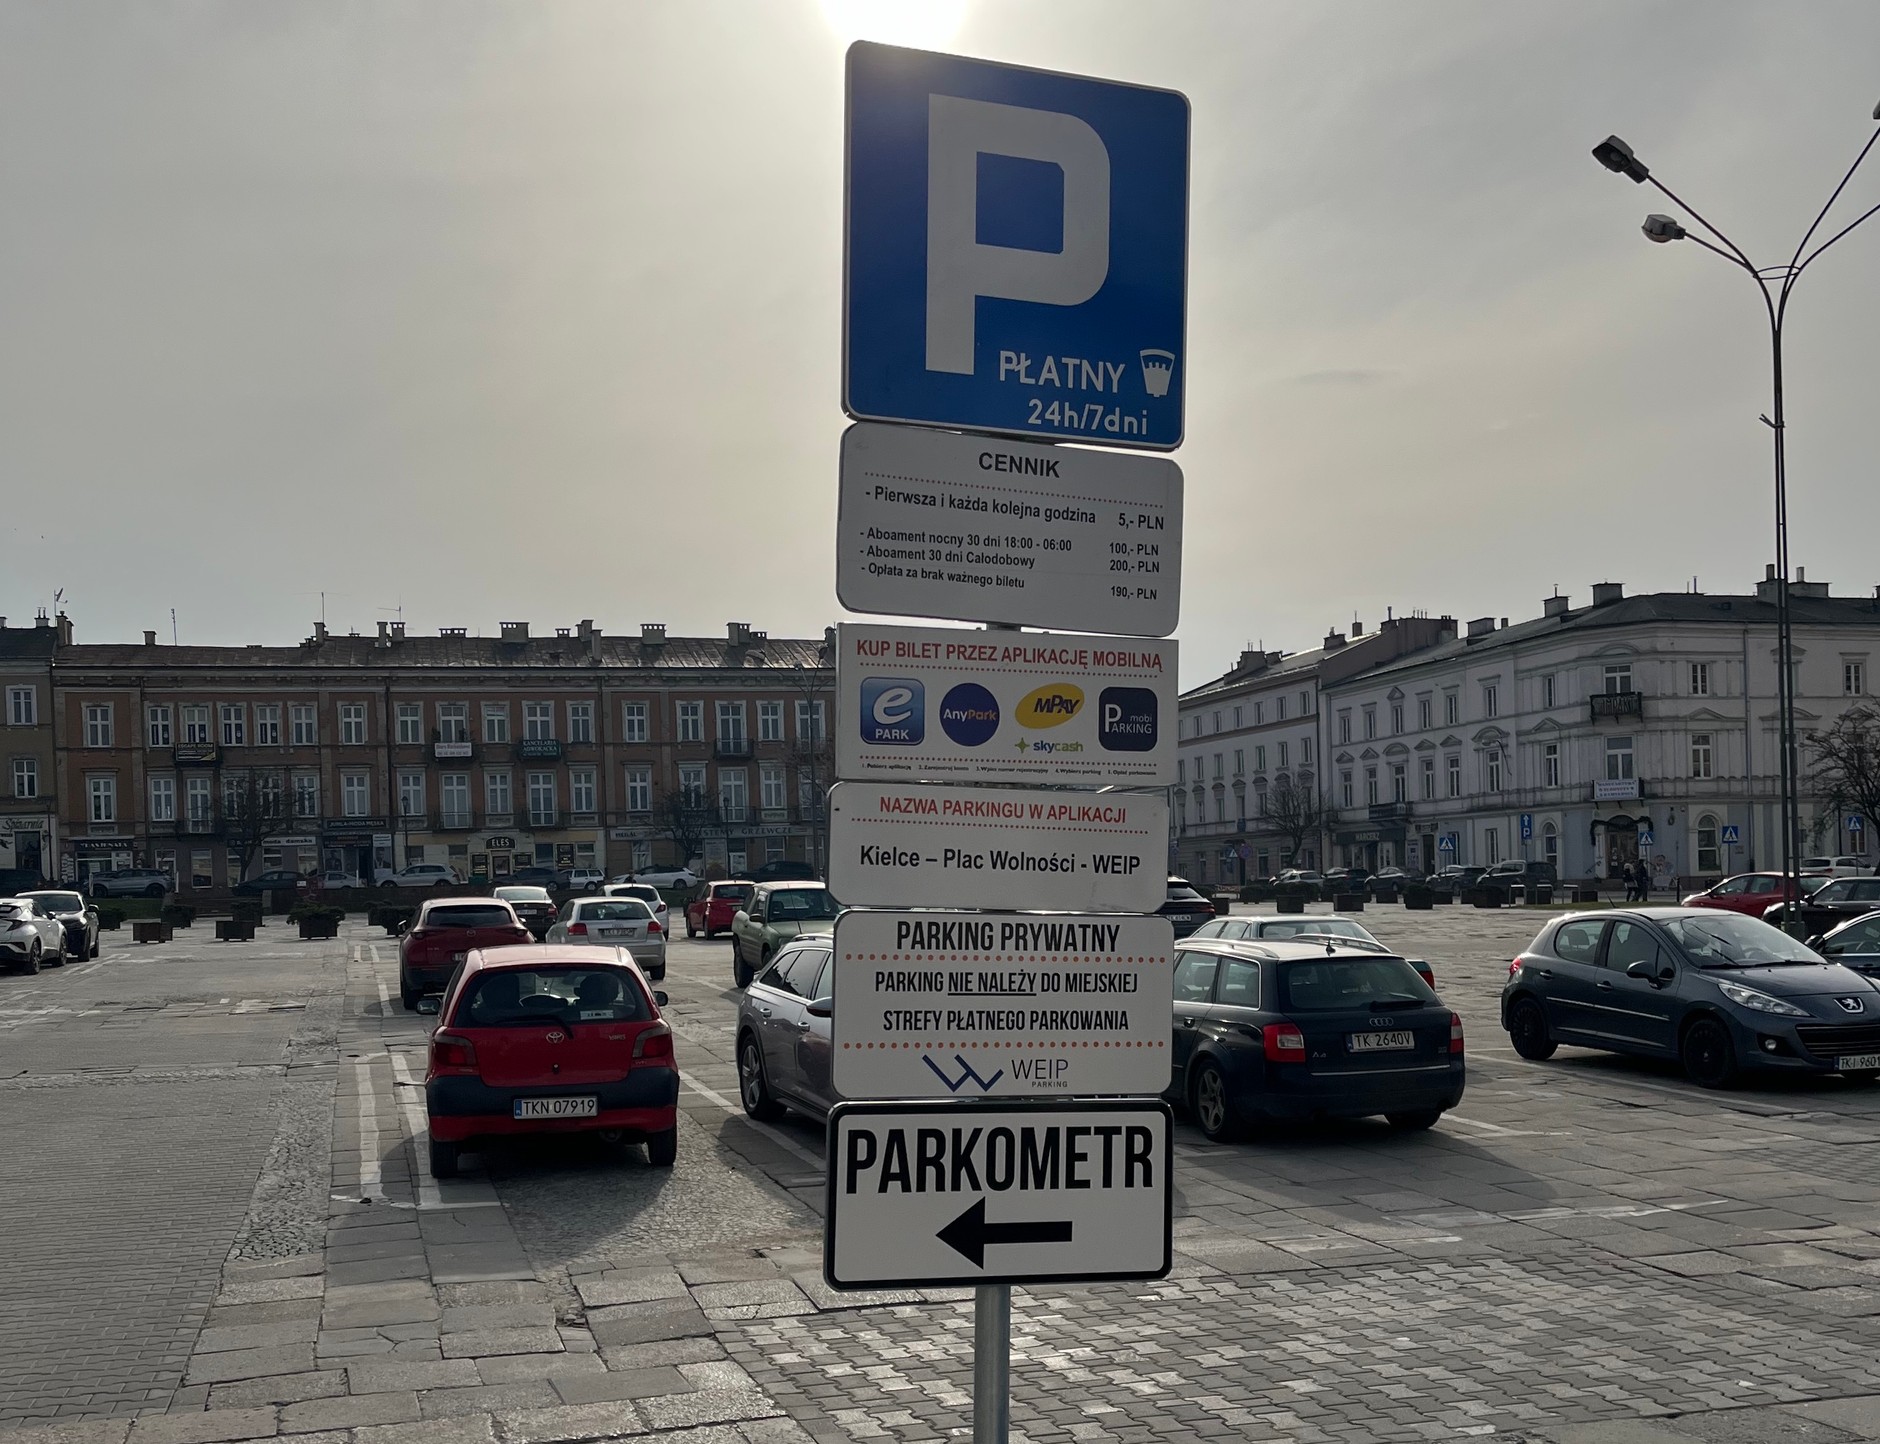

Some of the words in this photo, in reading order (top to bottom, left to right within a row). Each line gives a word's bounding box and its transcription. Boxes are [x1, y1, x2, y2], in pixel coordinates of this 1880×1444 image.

[925, 93, 1111, 375] P
[1000, 350, 1125, 393] PŁATNY
[1027, 399, 1148, 435] 24h/7dni
[978, 452, 1060, 478] CENNIK
[874, 485, 937, 507] Pierwsza
[941, 493, 945, 507] i
[949, 494, 988, 512] każda
[992, 499, 1040, 520] kolejna
[1044, 506, 1096, 524] godzina
[1138, 514, 1164, 530] PLN
[866, 527, 926, 543] Aboament
[929, 535, 964, 548] nocny
[967, 534, 980, 546] 30
[983, 535, 1000, 547] dni
[1004, 536, 1033, 549] 18:00
[1043, 538, 1072, 551] 06:00
[866, 545, 926, 561] Aboament
[929, 549, 942, 561] 30
[945, 550, 963, 563] dni
[1137, 544, 1159, 556] PLN
[868, 562, 903, 577] Opłata
[905, 568, 918, 578] za
[921, 568, 944, 581] brak
[947, 571, 993, 588] ważnego
[996, 575, 1025, 588] biletu
[1138, 561, 1160, 573] PLN
[1137, 588, 1157, 600] PLN
[856, 639, 891, 657] KUP
[895, 641, 942, 659] BILET
[946, 644, 998, 662] PRZEZ
[1001, 646, 1088, 669] APLIKACJĘ
[1093, 651, 1163, 672] MOBILNĄ
[943, 708, 997, 722] AnyPark
[1104, 703, 1152, 734] PARKING
[1129, 713, 1152, 723] mobi
[875, 728, 909, 740] PARK
[1033, 740, 1084, 753] skycash
[880, 796, 938, 815] NAZWA
[943, 799, 1024, 819] PARKINGU
[1029, 803, 1047, 820] W
[1047, 805, 1126, 824] APLIKACJI
[491, 838, 510, 847] ELES
[1523, 827, 1530, 838] P
[860, 845, 920, 867] Kielce
[943, 849, 984, 870] Plac
[990, 850, 1075, 873] Wolności
[1093, 854, 1140, 875] WEIP
[897, 920, 994, 951] PARKING
[1001, 922, 1120, 952] PRYWATNY
[875, 971, 944, 992] PARKING
[948, 972, 973, 993] NIE
[977, 969, 1037, 993] NALEŻY
[1040, 972, 1062, 993] DO
[1065, 973, 1138, 993] MIEJSKIEJ
[883, 1010, 943, 1031] STREFY
[947, 1010, 1025, 1031] PŁATNEGO
[1029, 1010, 1129, 1031] PARKOWANIA
[1354, 1034, 1371, 1048] TK
[1011, 1059, 1069, 1080] WEIP
[523, 1099, 551, 1115] TKN
[552, 1097, 596, 1114] 07919
[846, 1126, 1153, 1194] PARKOMETR
